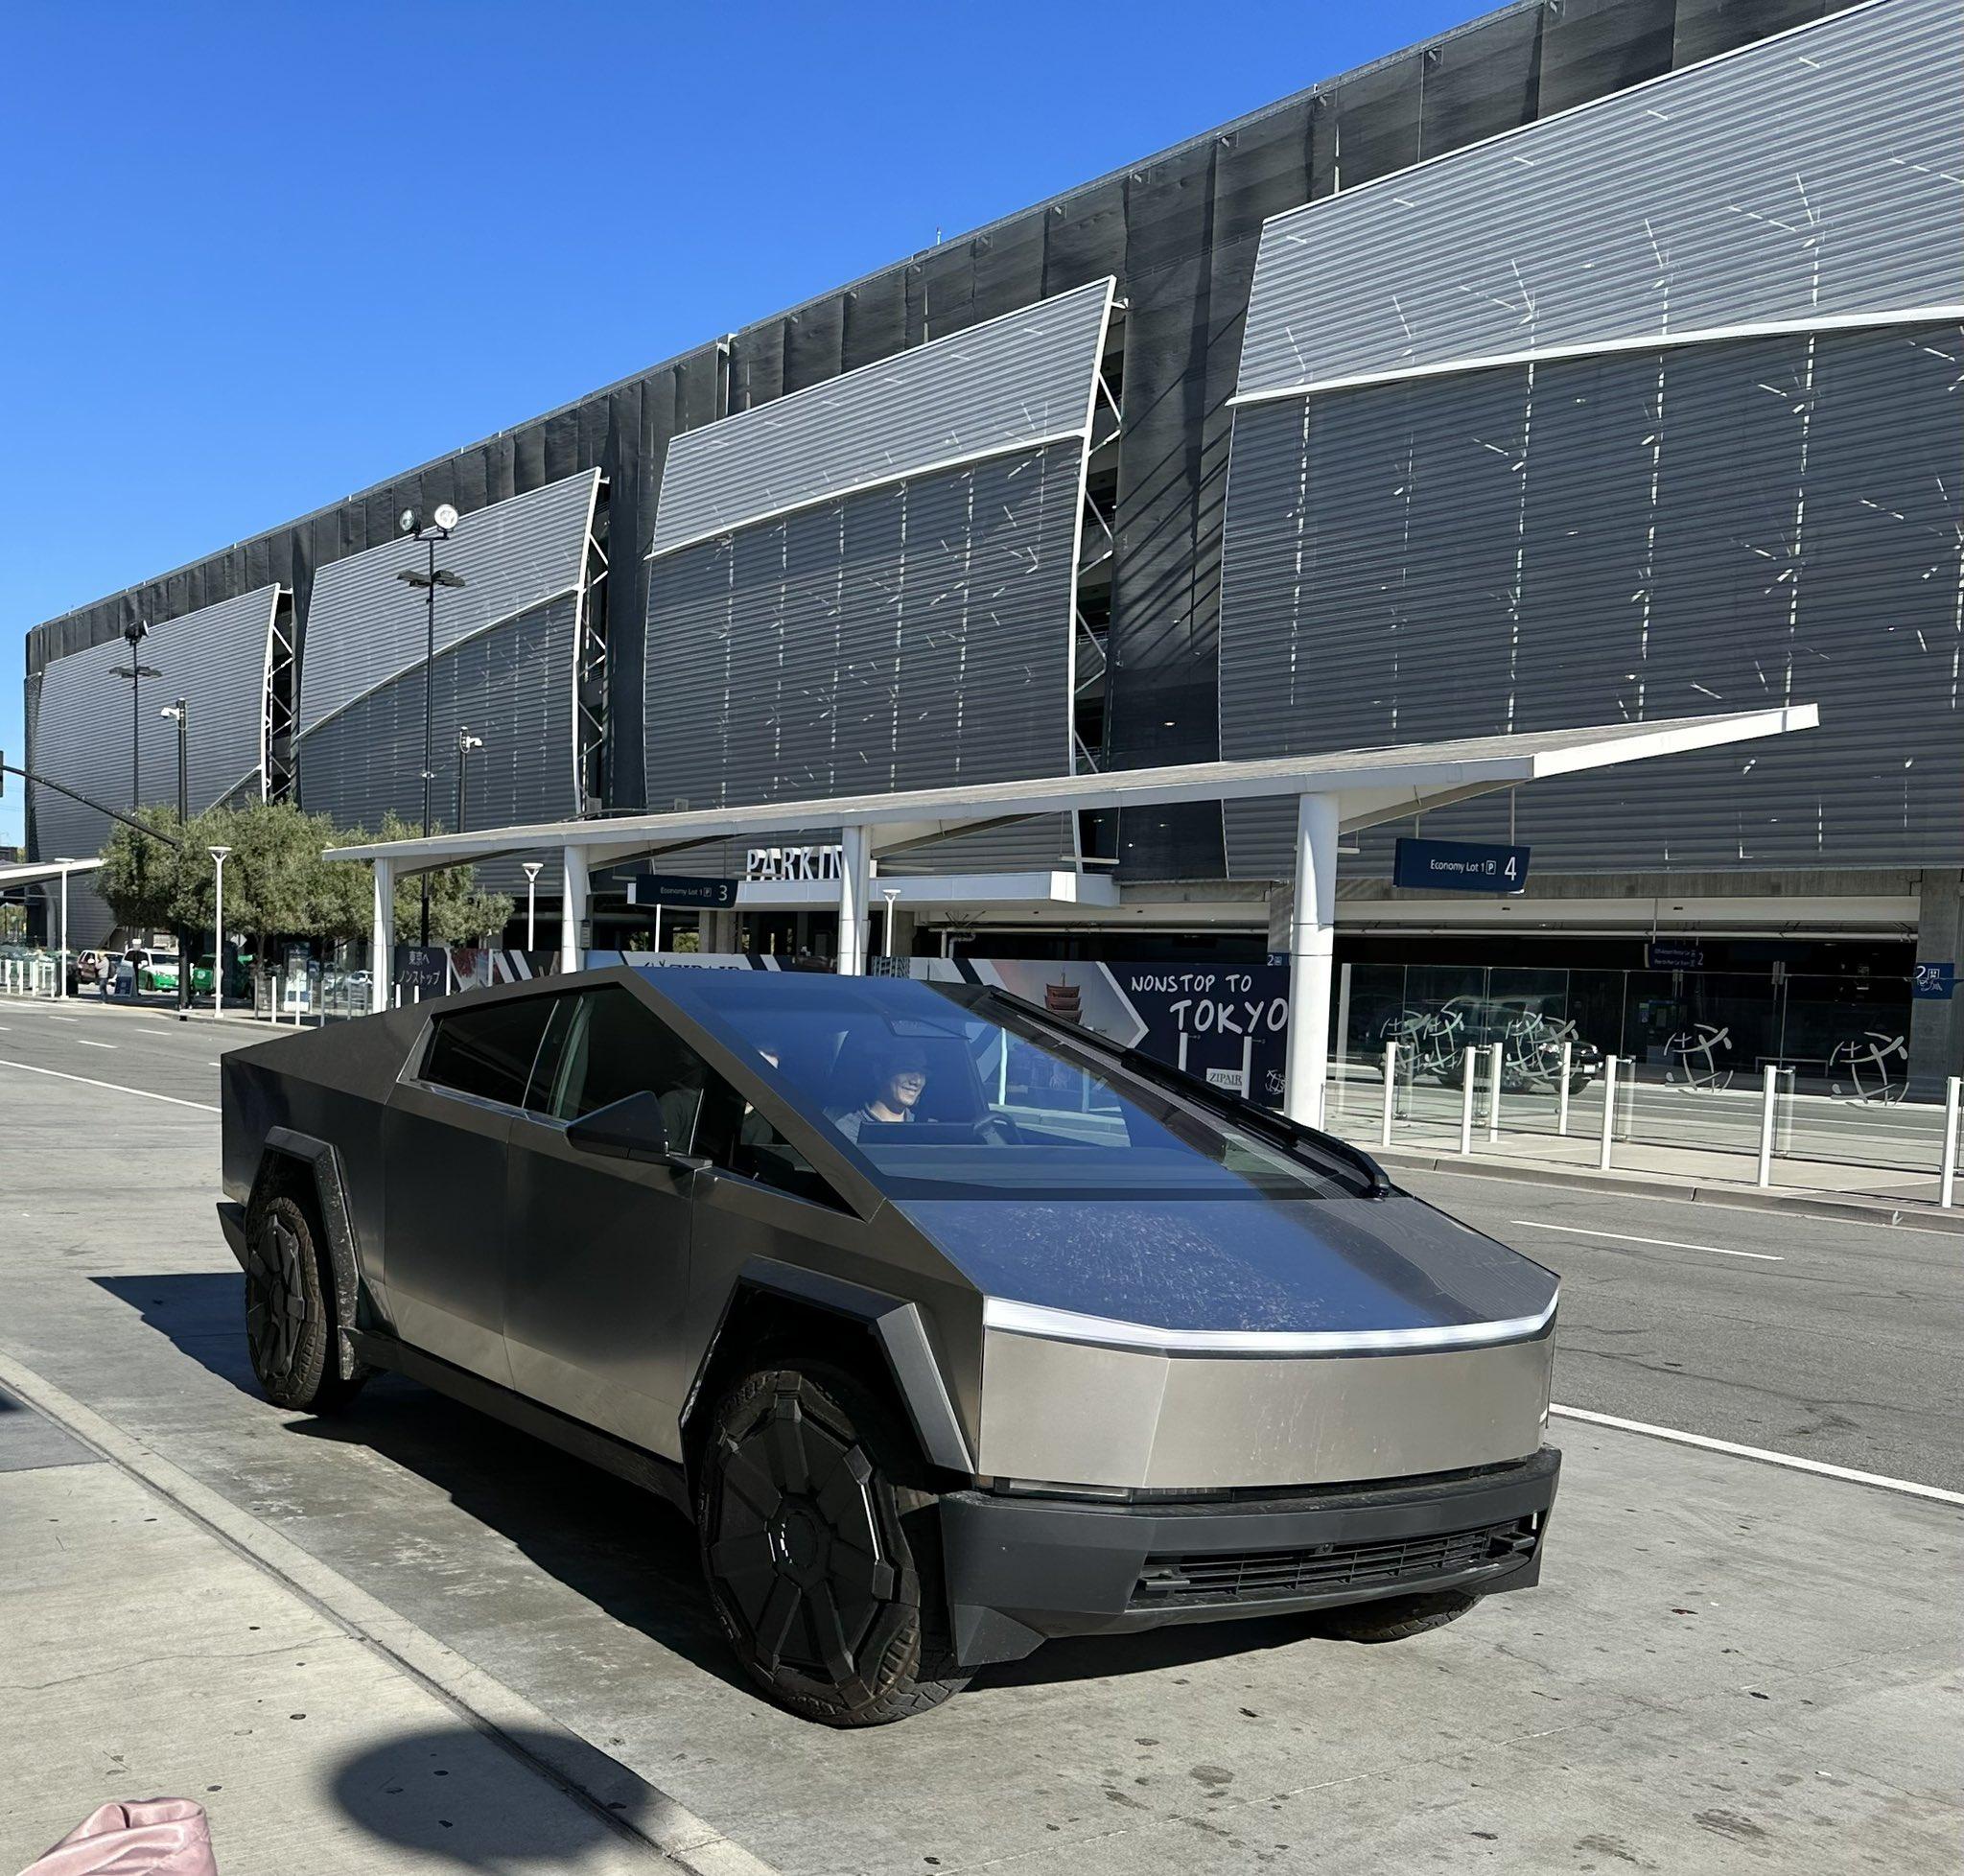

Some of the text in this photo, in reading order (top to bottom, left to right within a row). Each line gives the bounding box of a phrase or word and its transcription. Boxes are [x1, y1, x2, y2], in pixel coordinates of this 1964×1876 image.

[746, 845, 844, 881] PARKIN
[1430, 858, 1464, 874] Economy
[1465, 861, 1479, 872] Lot
[1480, 863, 1485, 873] 1
[1504, 856, 1517, 881] 4
[660, 886, 688, 896] Economy
[718, 884, 728, 902] 3
[1266, 954, 1274, 967] 2
[399, 970, 441, 985] ノンストップ
[1131, 973, 1252, 993] NONSTOP TO
[1169, 997, 1289, 1035] TOKYO
[1209, 1072, 1243, 1087] ZIPAIR
